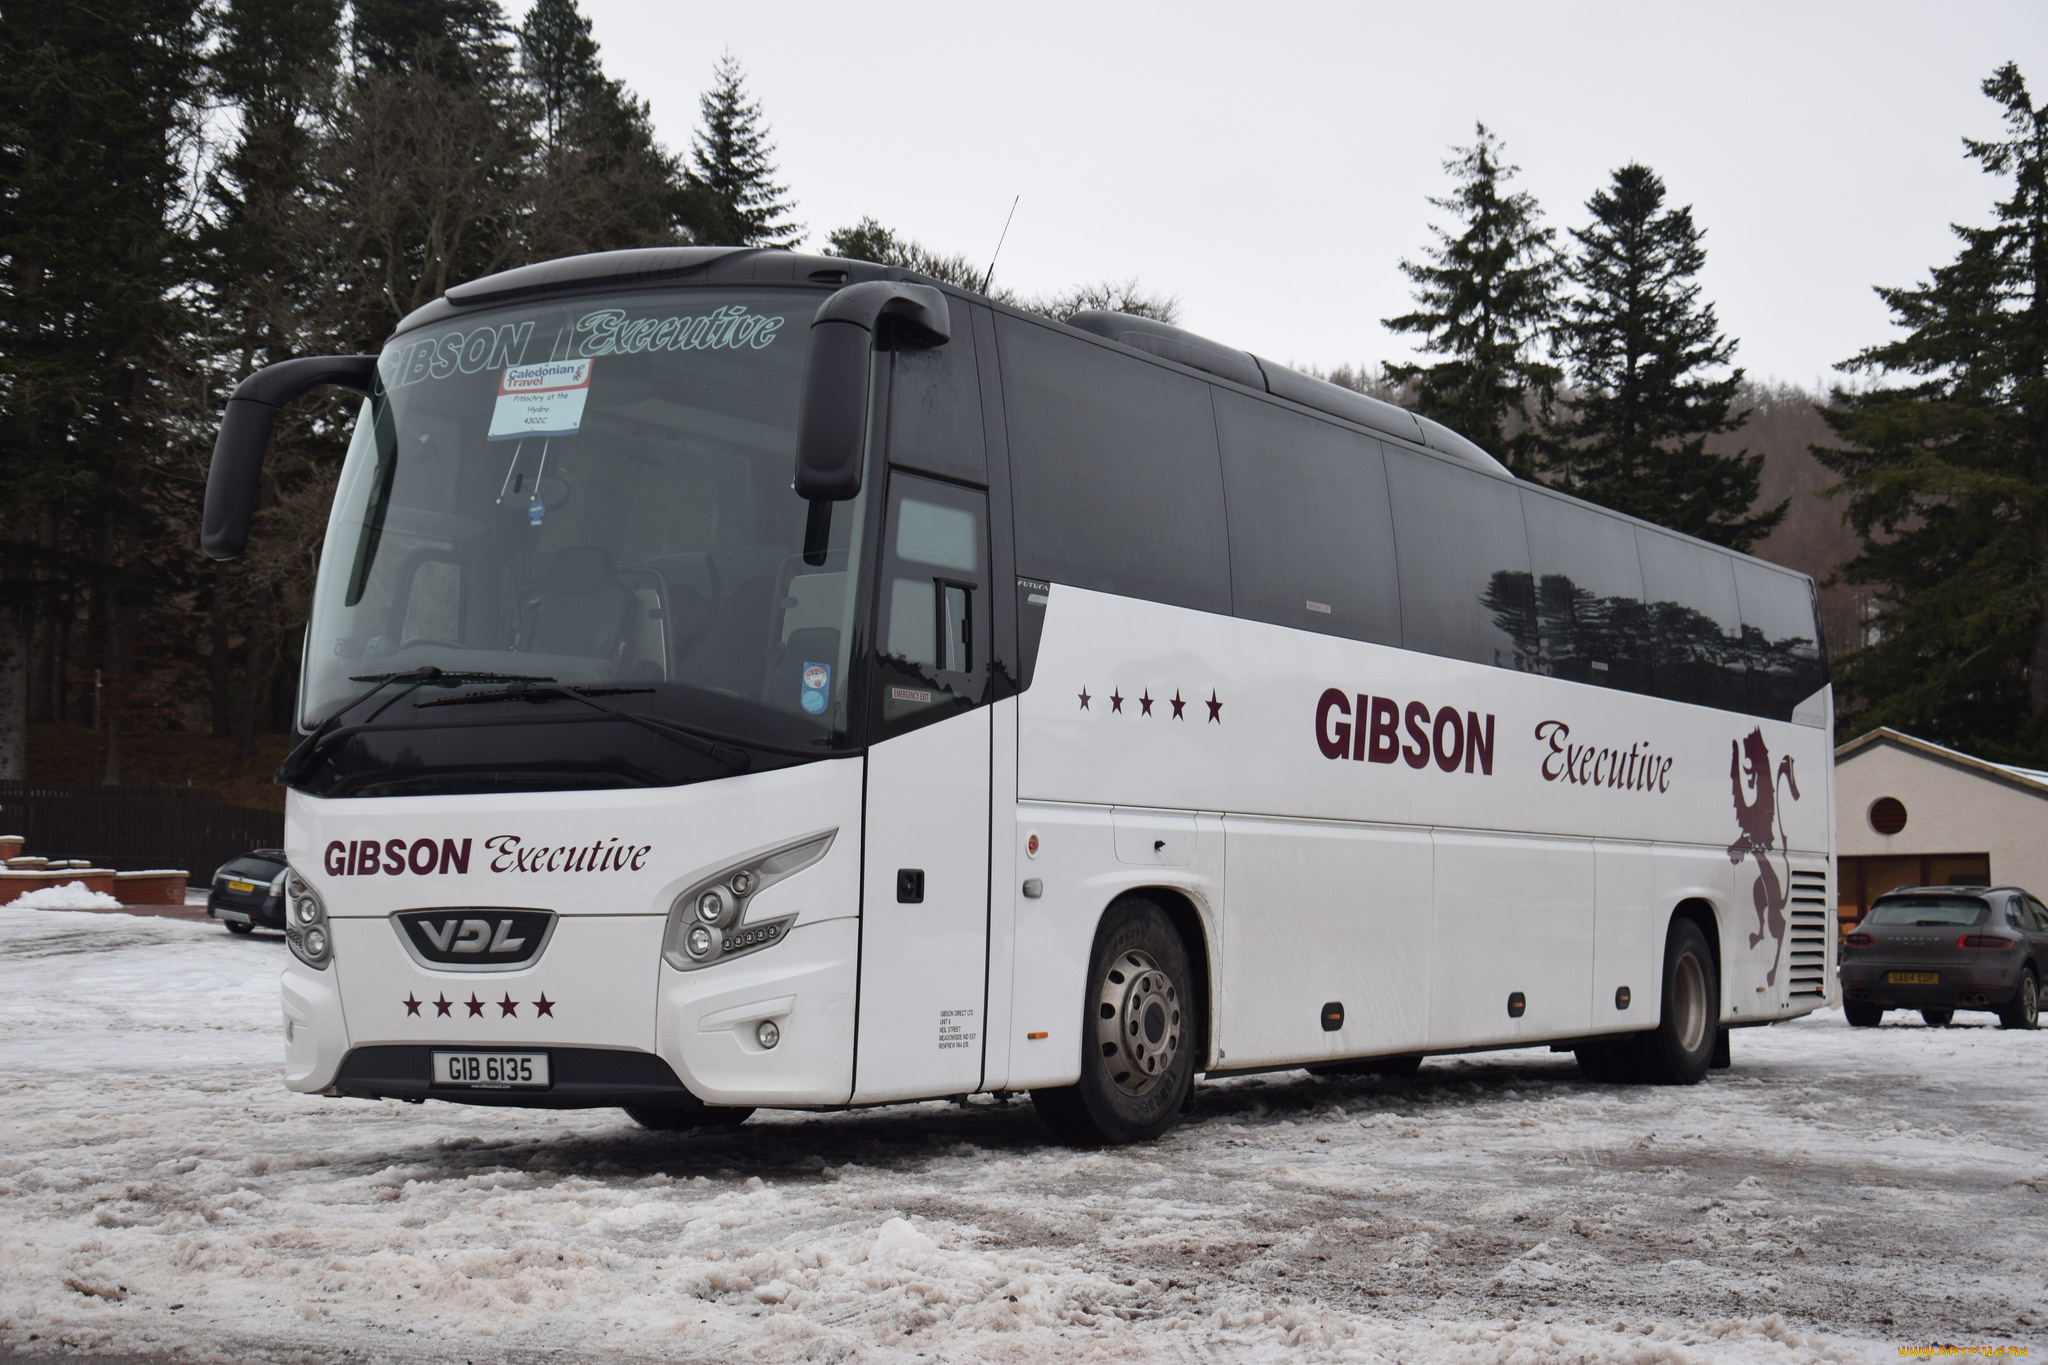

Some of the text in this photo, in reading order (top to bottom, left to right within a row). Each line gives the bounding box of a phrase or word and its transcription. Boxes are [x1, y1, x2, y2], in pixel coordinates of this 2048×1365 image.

[374, 305, 785, 397] GIBSON Executive
[508, 366, 574, 379] Caledonian
[507, 376, 543, 388] Travel
[513, 392, 569, 402] Pitlochry at the
[527, 406, 550, 414] Hydro
[1017, 580, 1049, 591] FUTURA
[893, 689, 930, 702] EMERGENCY EXIT
[1315, 687, 1674, 794] GIBSON Executive
[324, 835, 652, 876] GIBSON Executive
[417, 919, 527, 953] VDL
[948, 1025, 961, 1033] STREET
[449, 1056, 533, 1082] GIB 6135
